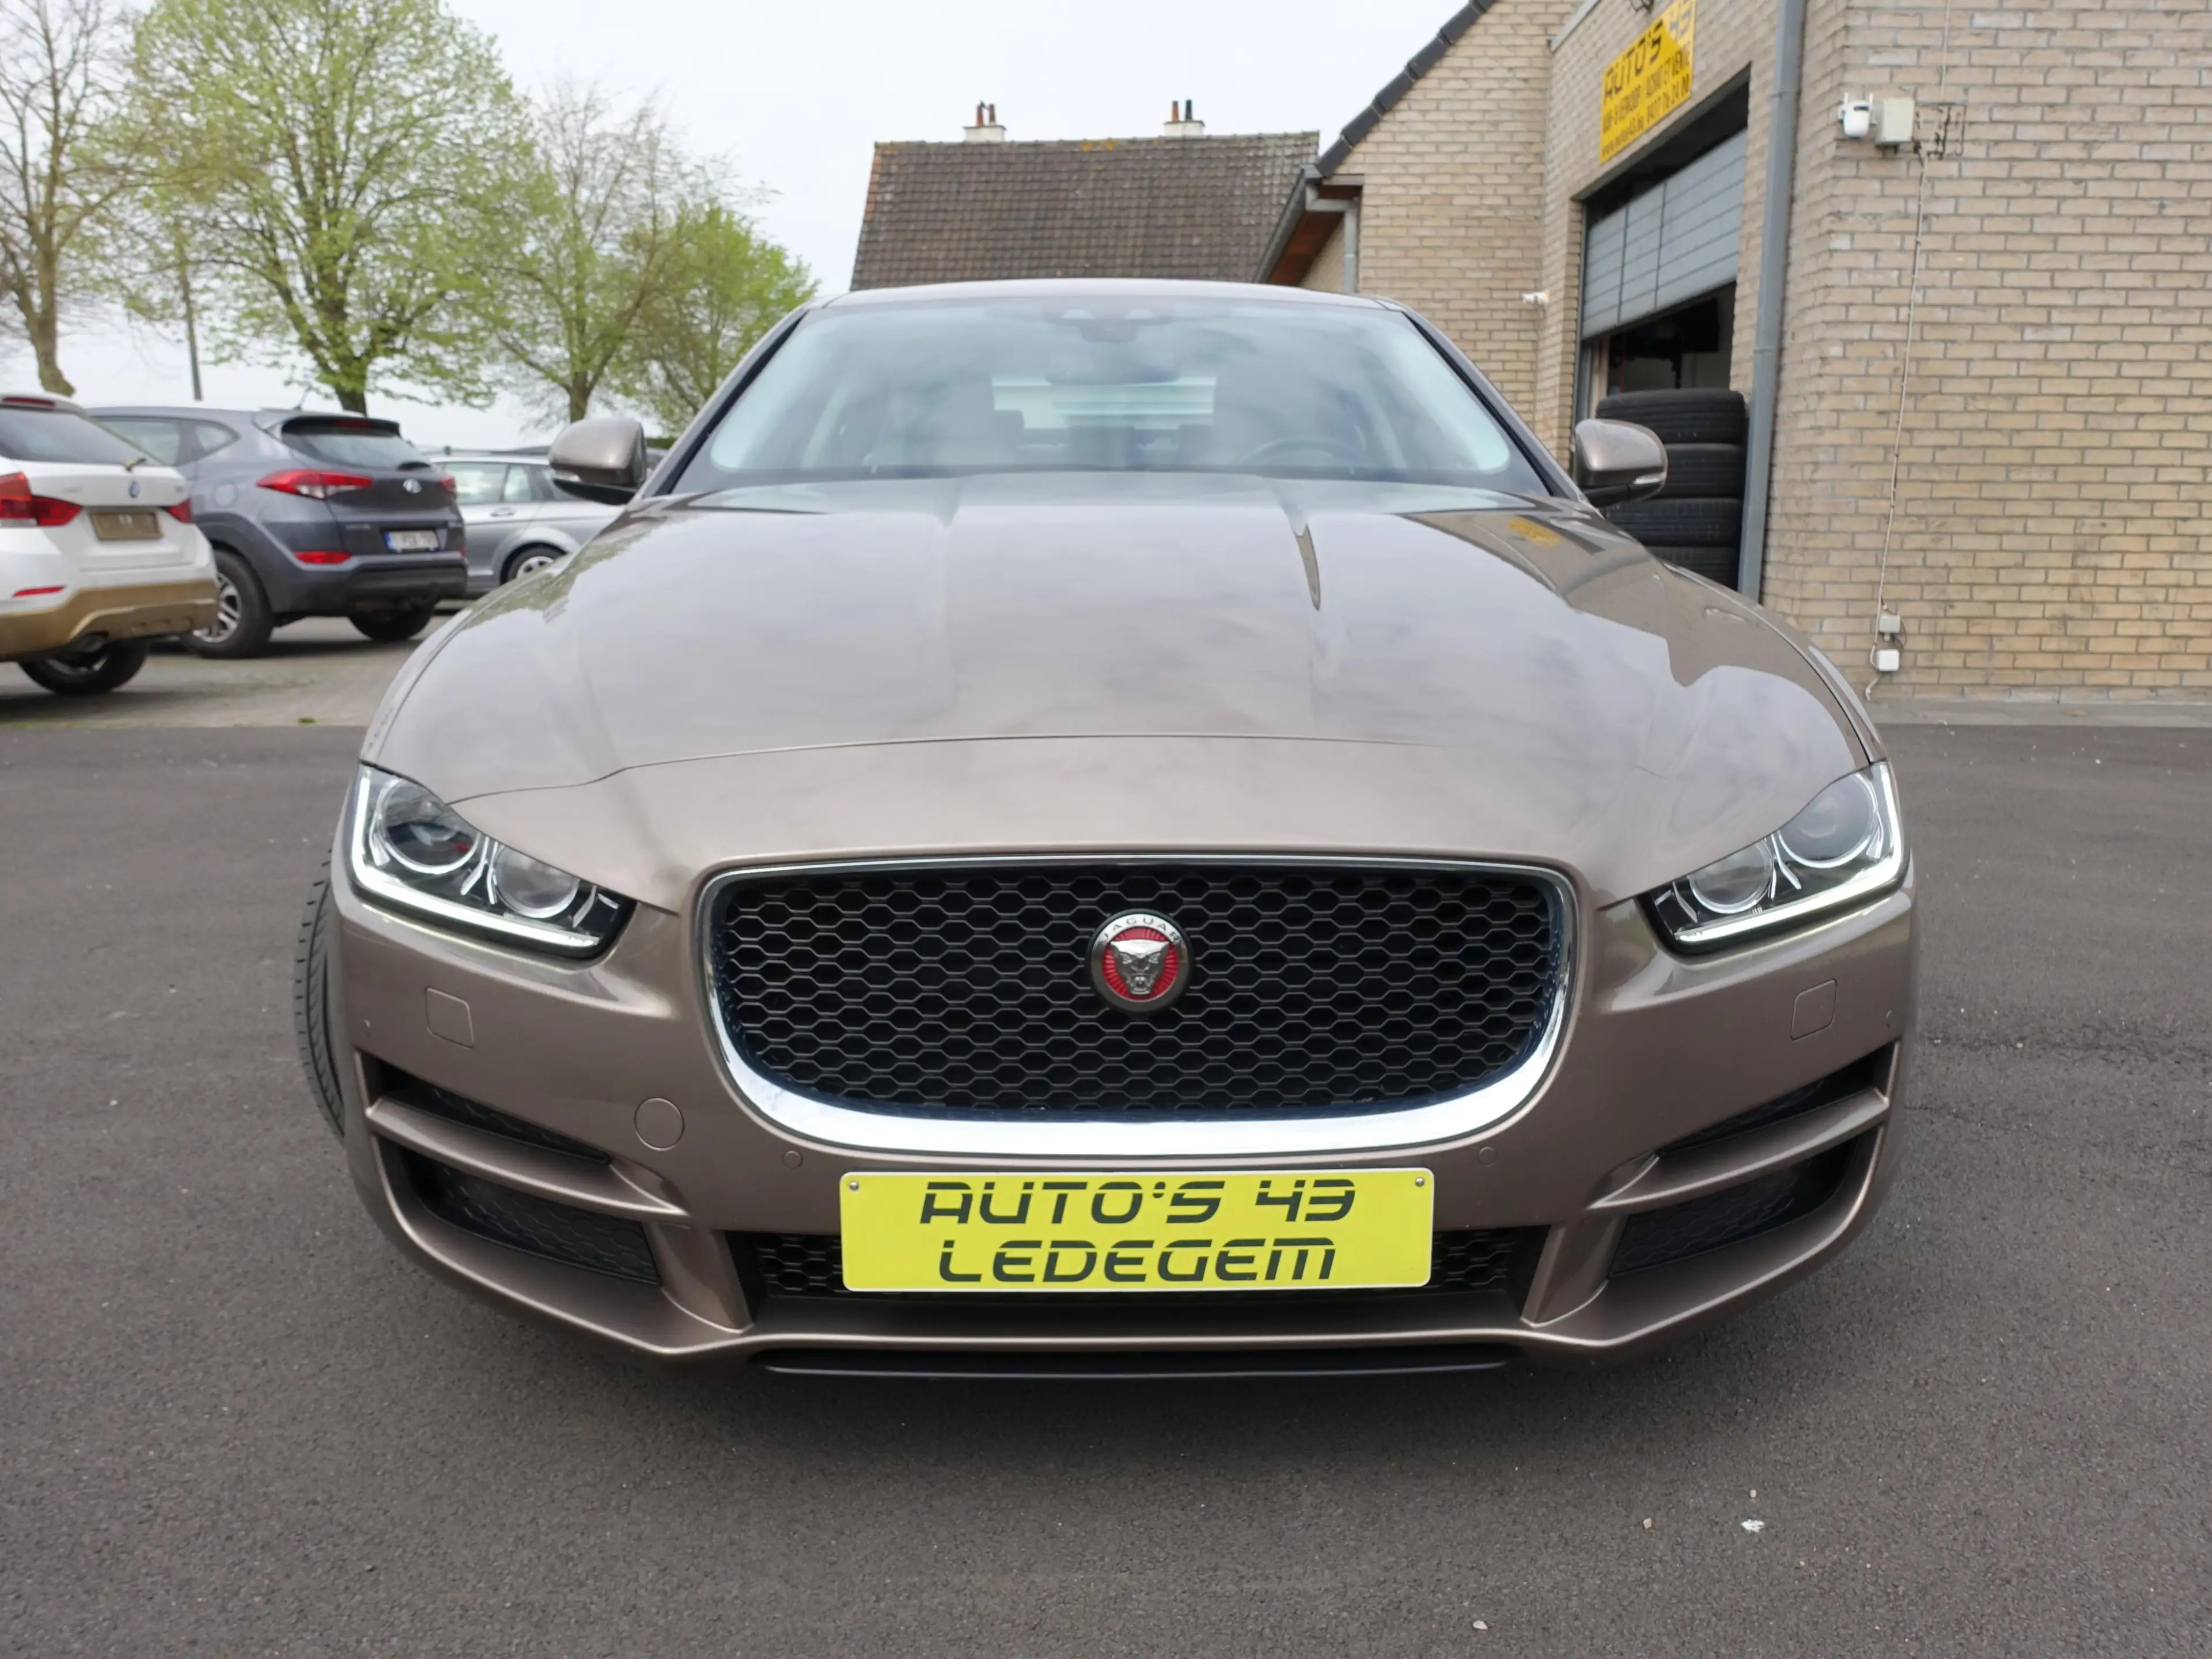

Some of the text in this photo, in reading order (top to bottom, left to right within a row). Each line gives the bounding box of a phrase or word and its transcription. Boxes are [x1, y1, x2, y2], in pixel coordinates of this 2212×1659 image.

[1102, 916, 1180, 943] JAGUAR
[919, 1179, 1356, 1224] AUTO'S 43
[938, 1237, 1336, 1283] LEDEGEM
